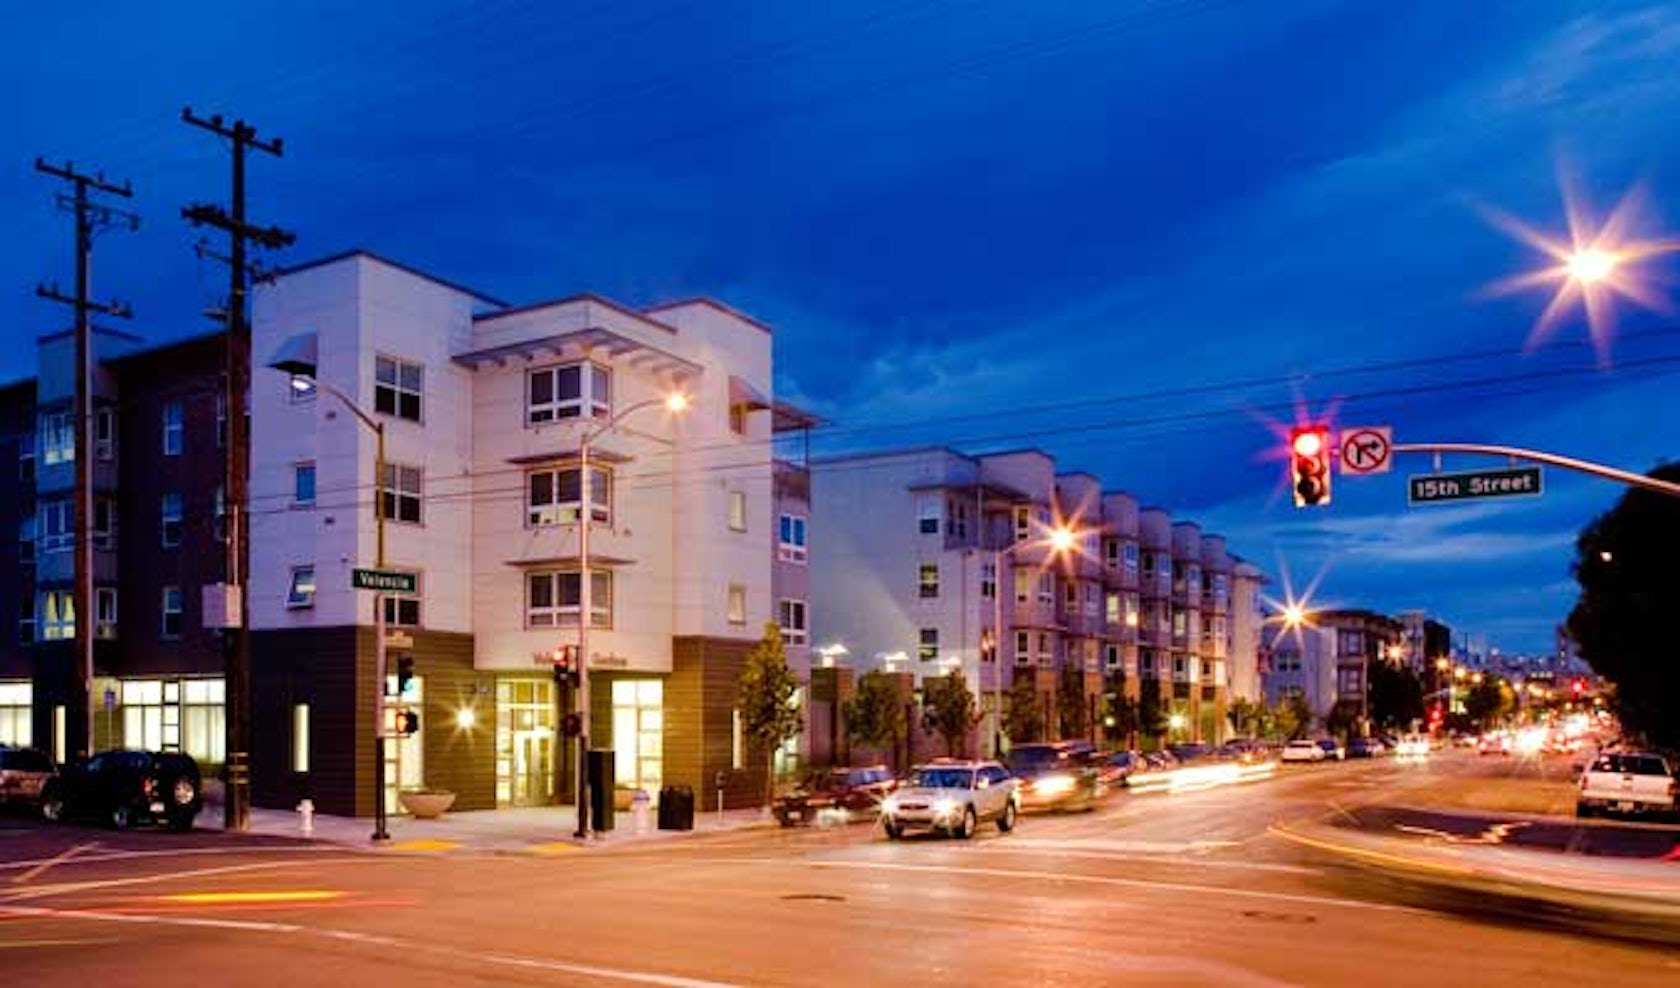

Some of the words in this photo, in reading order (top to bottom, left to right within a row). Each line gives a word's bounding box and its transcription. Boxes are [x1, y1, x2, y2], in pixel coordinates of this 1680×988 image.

[1416, 481, 1459, 498] 15th
[1469, 475, 1532, 494] Street
[359, 572, 410, 589] Valencia
